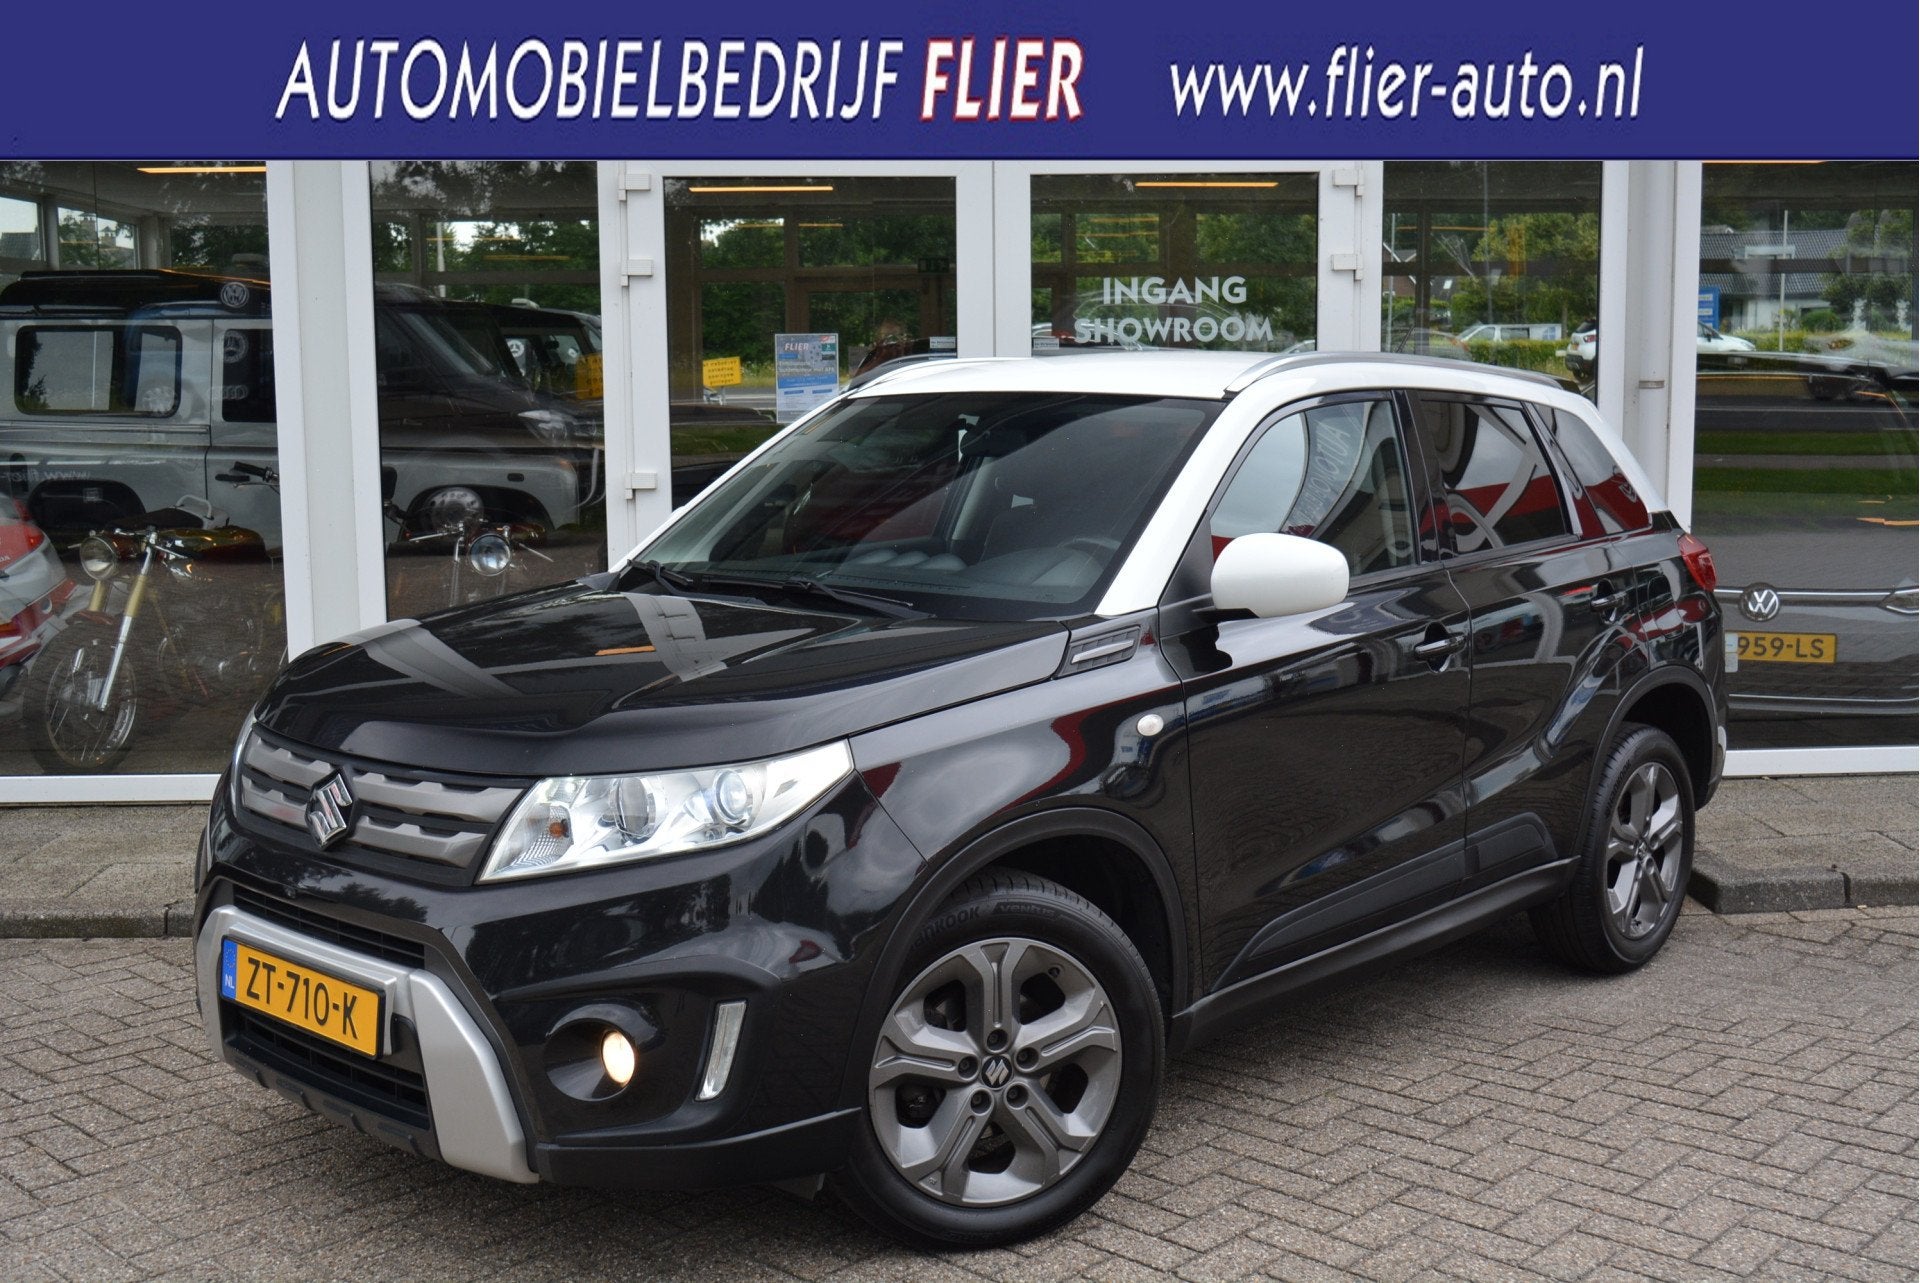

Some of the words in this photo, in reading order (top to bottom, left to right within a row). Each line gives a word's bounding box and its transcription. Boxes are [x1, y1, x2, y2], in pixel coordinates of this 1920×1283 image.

[1103, 275, 1248, 305] INGANG
[1074, 316, 1274, 344] SHOWROOM
[784, 342, 810, 351] FLIER
[225, 974, 235, 989] NL
[246, 956, 358, 1040] ZT-710-K
